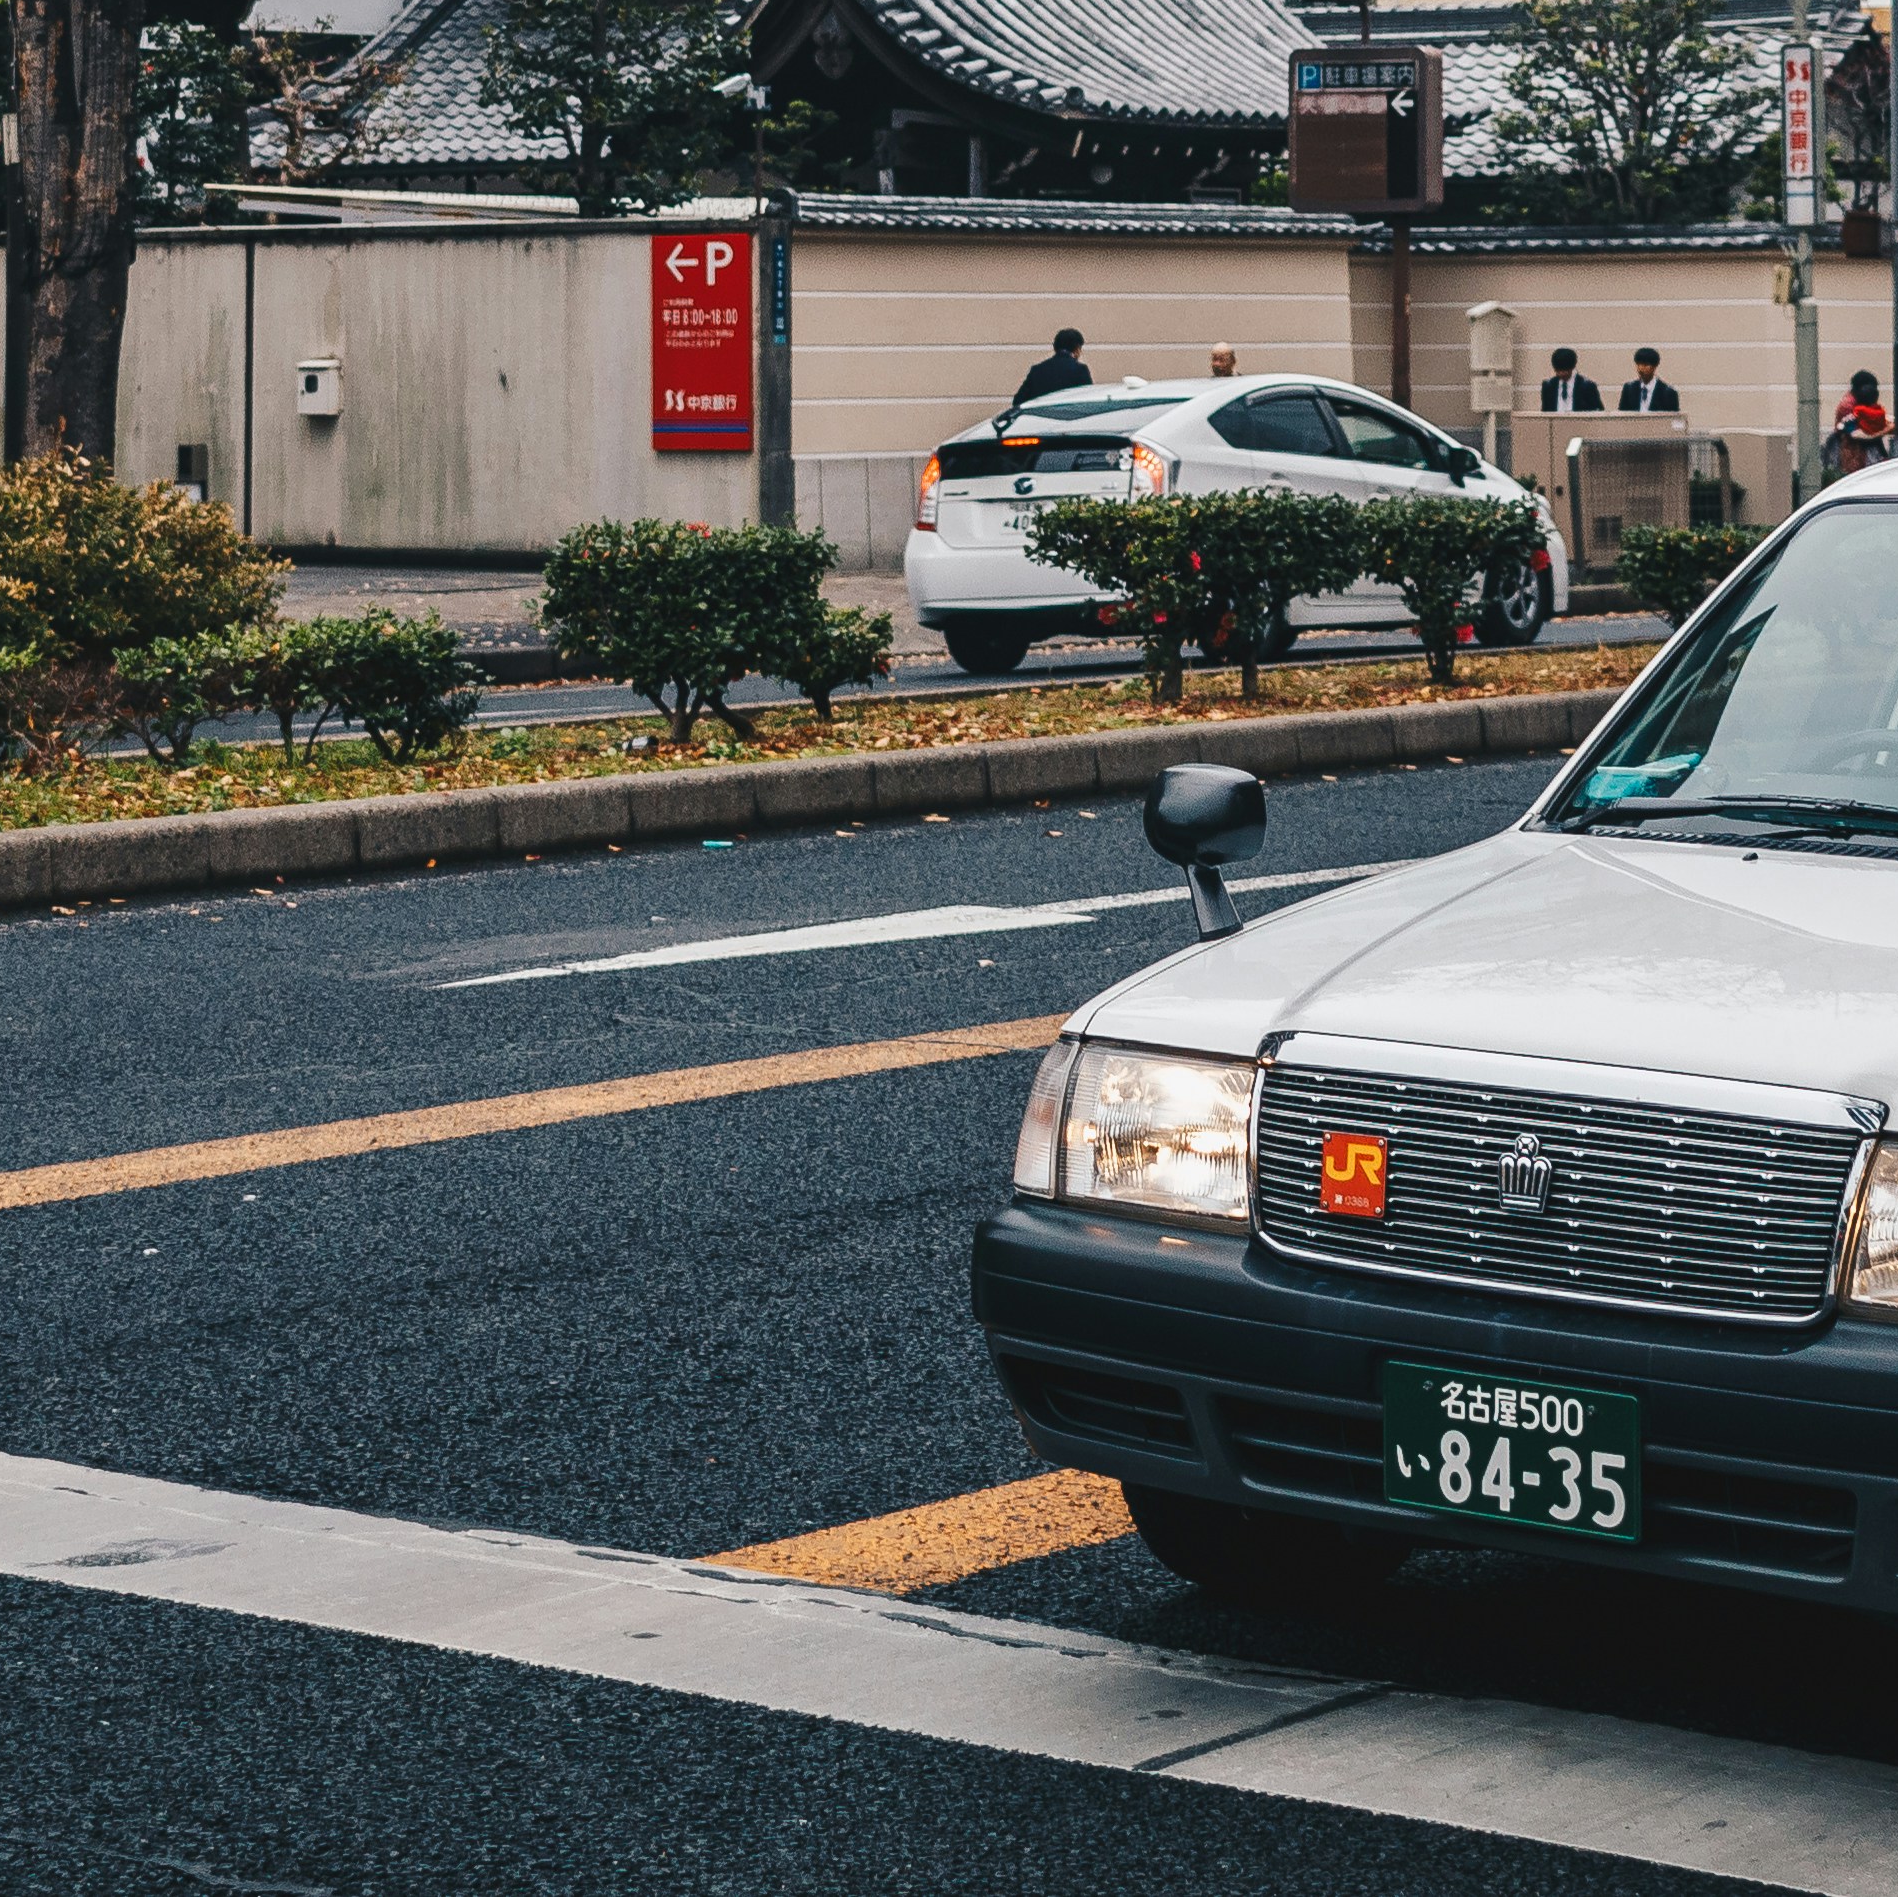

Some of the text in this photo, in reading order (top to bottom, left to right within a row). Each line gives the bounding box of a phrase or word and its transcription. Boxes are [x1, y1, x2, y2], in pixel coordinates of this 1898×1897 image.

[1789, 89, 1808, 172] 中京銀行
[706, 241, 734, 286] P
[688, 394, 737, 411] 中京銀行
[1325, 1143, 1383, 1185] JR
[1396, 1429, 1627, 1529] い 84-35
